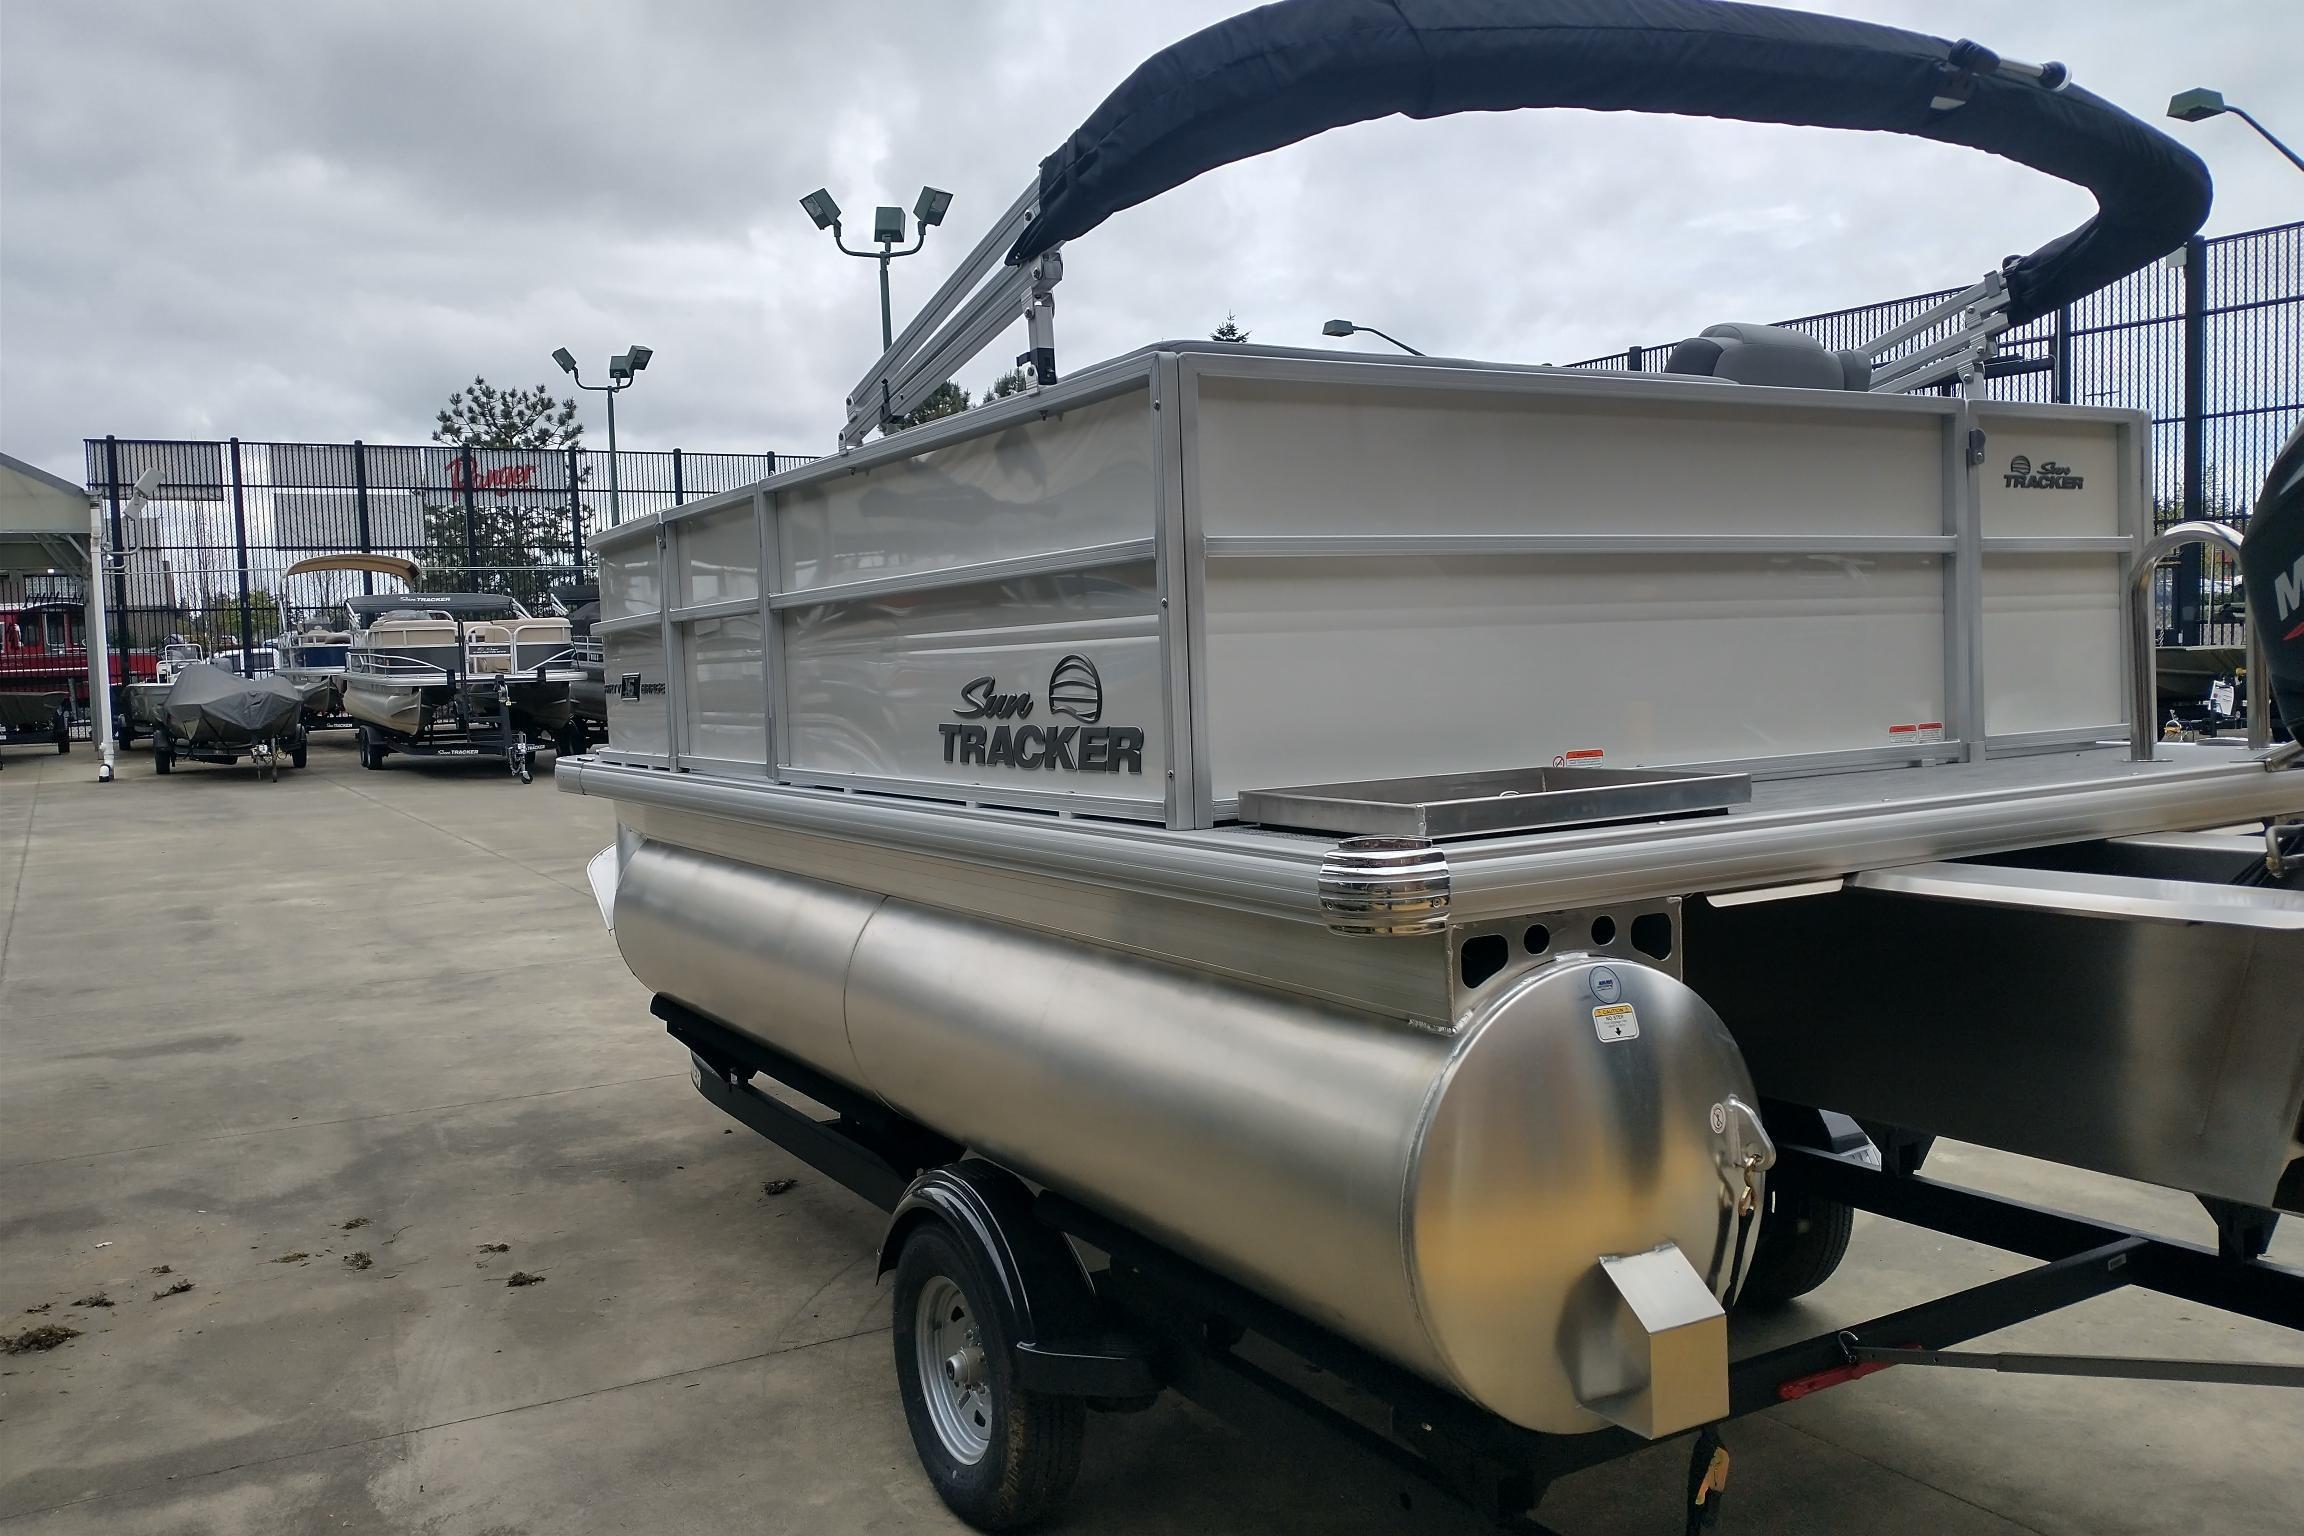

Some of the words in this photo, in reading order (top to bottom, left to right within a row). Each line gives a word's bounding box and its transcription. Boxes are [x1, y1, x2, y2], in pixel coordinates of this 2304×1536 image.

[445, 455, 536, 502] Ranger
[2004, 474, 2084, 490] TRACKER
[2037, 461, 2071, 476] Sun
[953, 675, 1034, 720] Sun
[938, 723, 1144, 774] TRACKER
